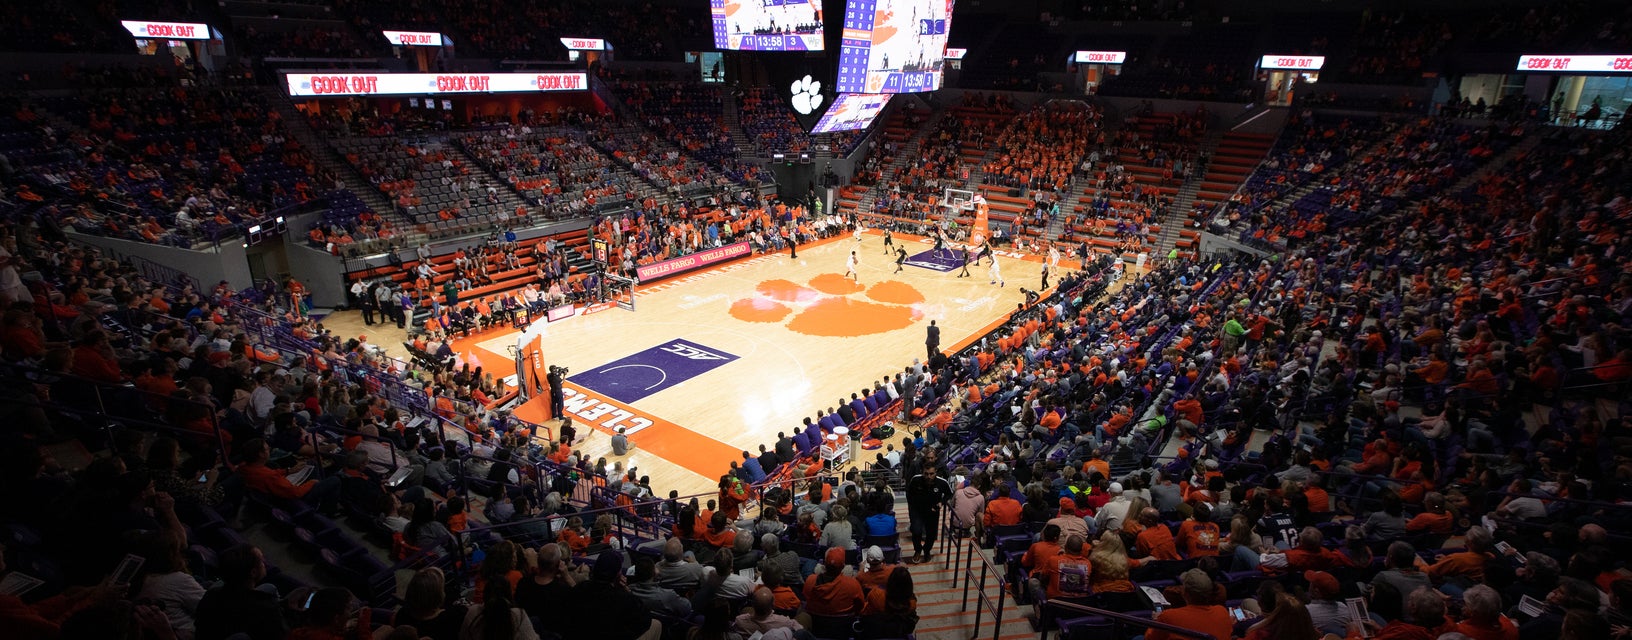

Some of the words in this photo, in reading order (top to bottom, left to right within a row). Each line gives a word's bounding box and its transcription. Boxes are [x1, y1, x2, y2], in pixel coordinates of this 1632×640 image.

[147, 24, 175, 37] COOK
[176, 25, 195, 37] OUT
[419, 34, 431, 43] OUT
[745, 37, 753, 45] 11
[758, 36, 782, 47] 13:58
[790, 37, 796, 46] 3
[949, 50, 959, 58] OUT
[1527, 57, 1552, 69] COOK
[1553, 57, 1571, 69] OUT
[311, 76, 351, 94] COOK
[352, 76, 377, 93] OUT
[437, 75, 468, 91] COOK
[469, 75, 490, 91] OUT
[537, 75, 562, 90] COOK
[563, 75, 580, 89] OUT
[890, 75, 898, 87] 11
[904, 73, 924, 88] 13:58
[926, 75, 931, 86] 3
[700, 250, 725, 262] WELLS
[724, 244, 747, 256] FARGO
[641, 264, 670, 277] WELLS
[671, 257, 696, 270] FARGO
[660, 343, 730, 361] ACC
[1280, 528, 1299, 548] 12
